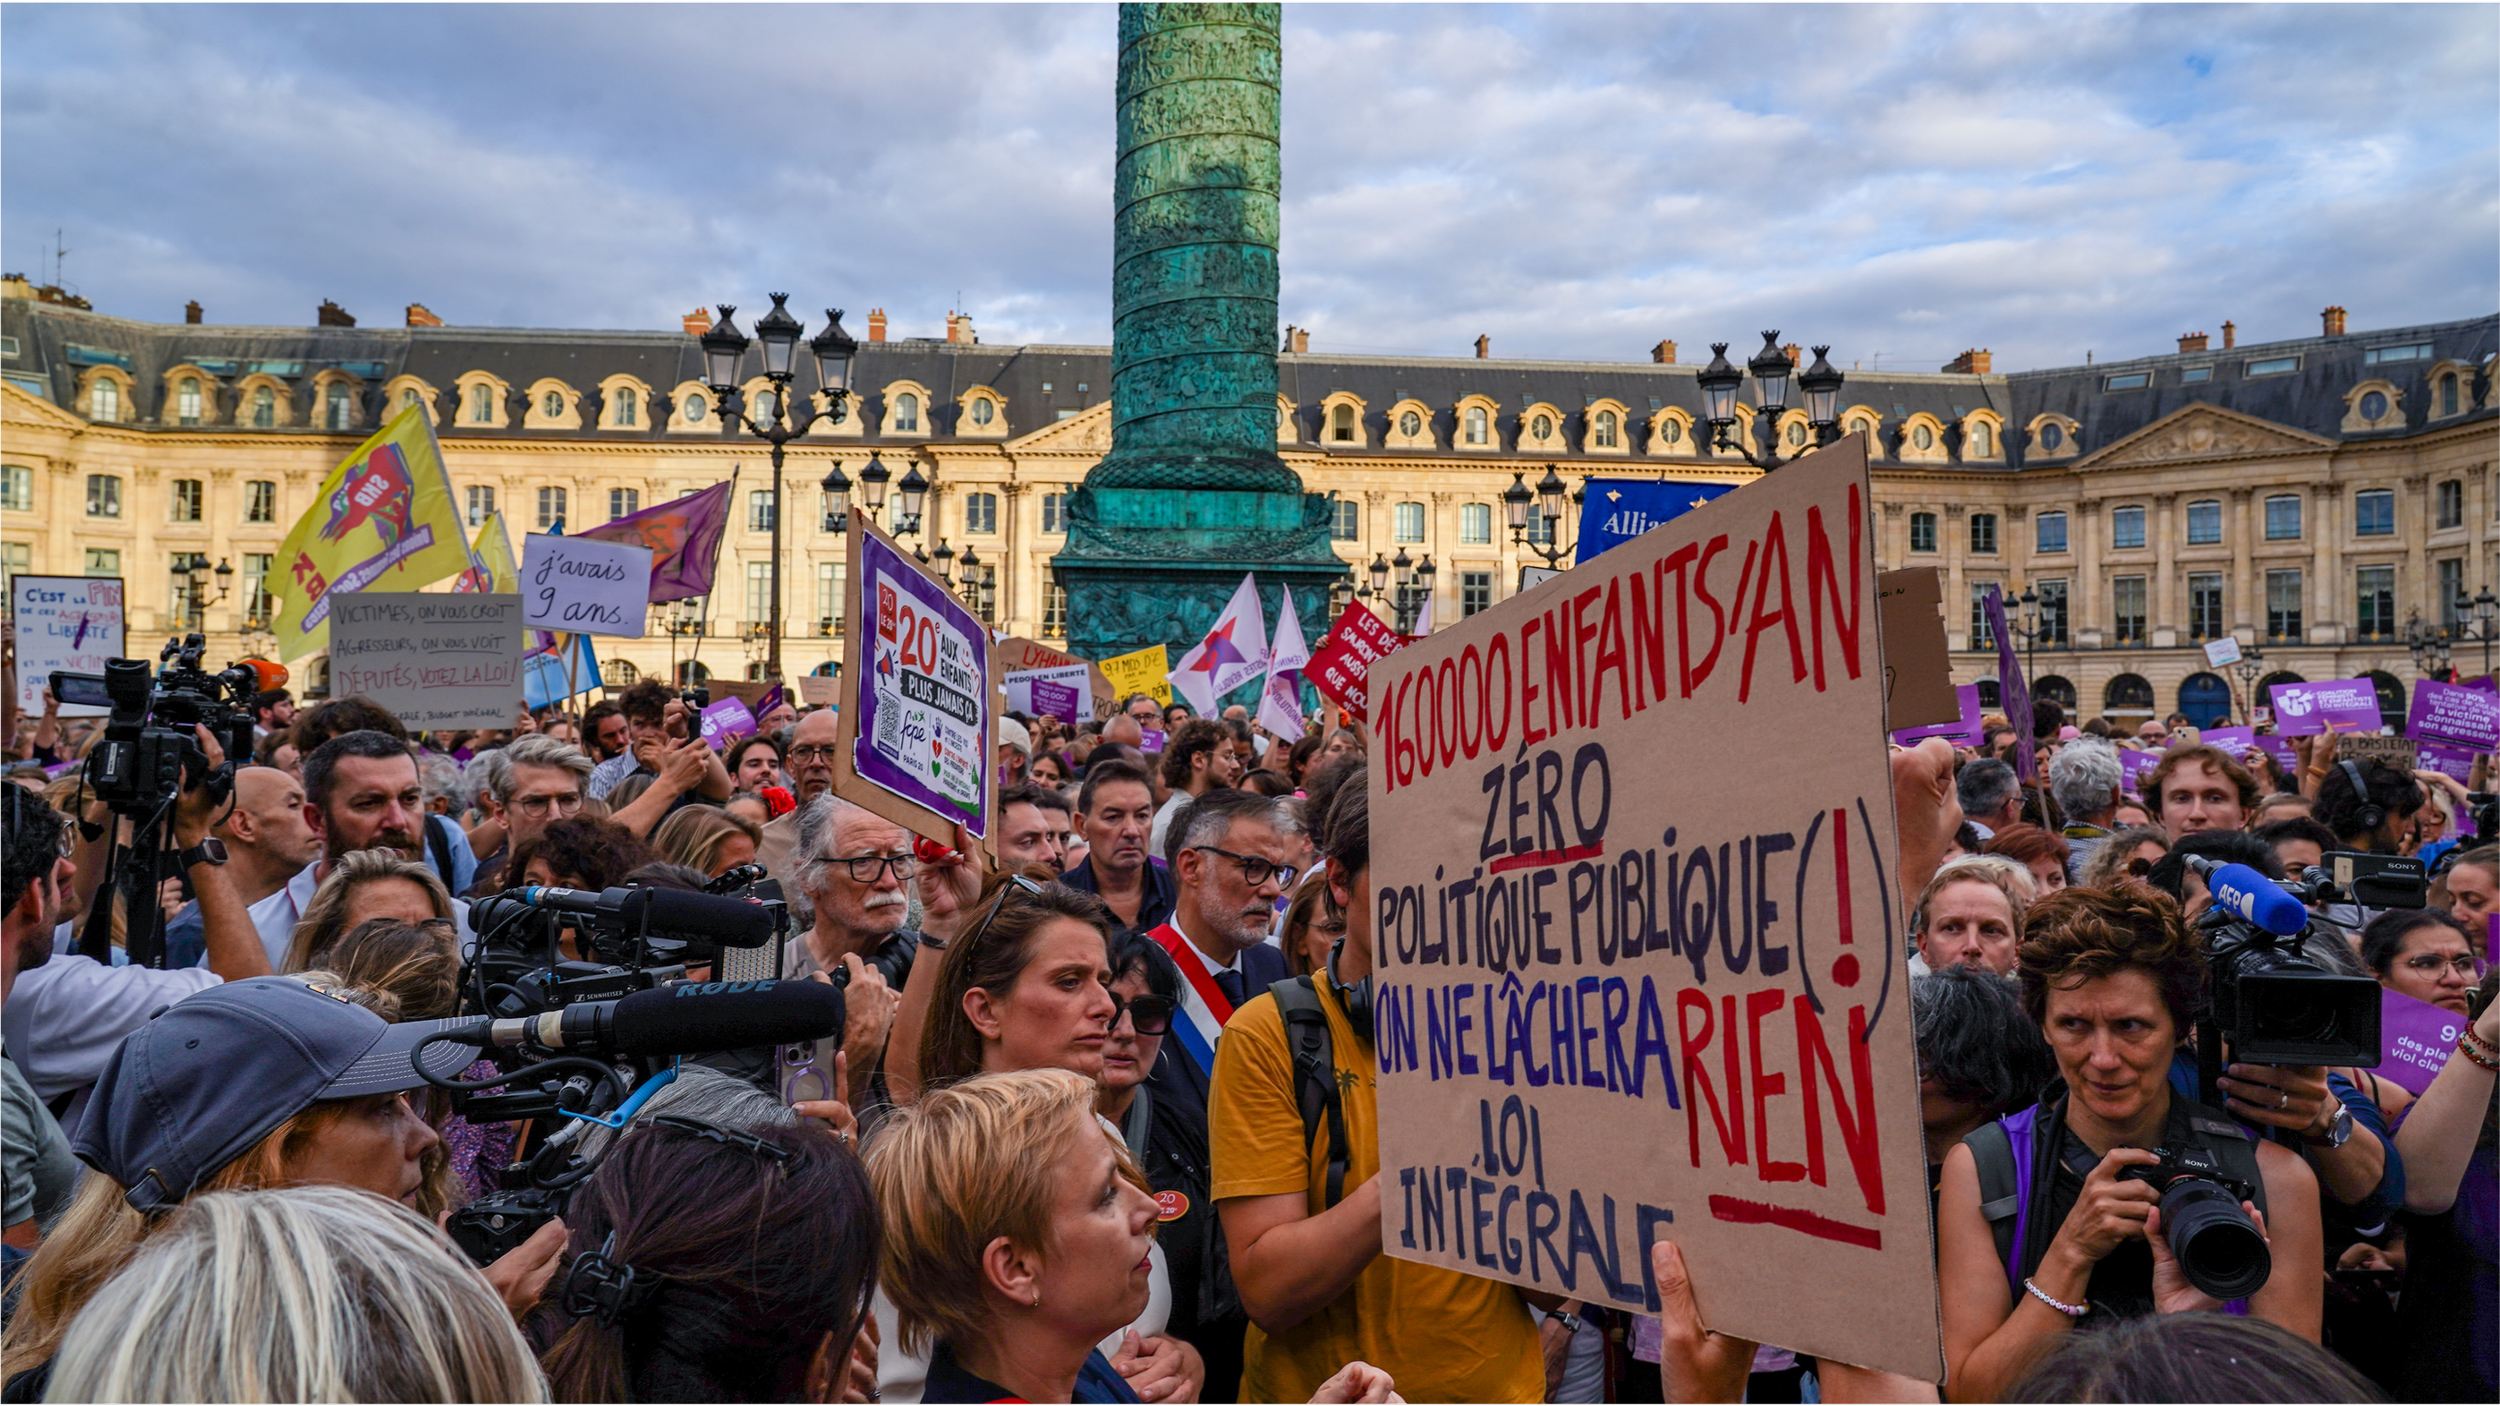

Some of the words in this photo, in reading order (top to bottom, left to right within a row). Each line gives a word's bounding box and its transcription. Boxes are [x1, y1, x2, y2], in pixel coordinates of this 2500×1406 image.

[535, 549, 626, 586] j'avais
[26, 588, 66, 603] C'EST
[88, 580, 122, 607] FIN
[337, 603, 416, 625] VICTIMES,
[418, 605, 437, 619] ON
[439, 605, 469, 619] VOUS
[530, 586, 557, 619] 9
[563, 601, 629, 625] ans.
[1357, 612, 1380, 637] LES
[336, 638, 417, 659] AGRESSEURS,
[421, 638, 439, 649] ON
[443, 638, 468, 649] VOUS
[941, 633, 959, 663] AUX
[941, 657, 973, 694] ENFANTS
[1051, 668, 1086, 680] LIBERTÉ
[1339, 652, 1368, 682] AUSSI
[338, 662, 418, 699] DÉPUTÉS,
[418, 666, 460, 686] VOTEZ
[464, 666, 482, 683] LA
[1325, 666, 1347, 691] QUE
[1344, 685, 1368, 709] NOU
[908, 674, 934, 702] PLUS
[935, 686, 964, 717] JAMAIS
[1050, 692, 1067, 702] 000
[2427, 691, 2443, 700] des
[2444, 694, 2460, 704] cas
[2461, 698, 2473, 706] de
[2475, 701, 2490, 710] viol
[2443, 687, 2465, 699] Dans
[2466, 692, 2486, 703] 90%
[1376, 632, 1512, 795] 160000
[2429, 698, 2468, 711] tentative
[2468, 705, 2480, 714] de
[2435, 704, 2446, 714] la
[2447, 709, 2491, 723] victime
[900, 710, 927, 750] fcpe
[2418, 720, 2440, 730] son
[2440, 724, 2499, 741] agresseur
[2426, 713, 2494, 733] connaissait
[903, 754, 919, 769] PARIS
[1482, 739, 1612, 863] ZÉRO
[2387, 862, 2417, 871] SONY
[2218, 883, 2242, 908] AFP
[586, 990, 624, 1000] SENNHEISER
[2397, 1035, 2423, 1052] des
[2440, 1024, 2460, 1043] 9
[2391, 1048, 2417, 1064] viol
[1376, 981, 1418, 1075] ON
[1427, 984, 1479, 1081] NE
[1485, 971, 1682, 1111] LÂCHERA
[1677, 988, 1886, 1216] RIEN
[1480, 1095, 1546, 1191] LOI
[2184, 1158, 2209, 1169] SONY
[1159, 1193, 1177, 1204] 20
